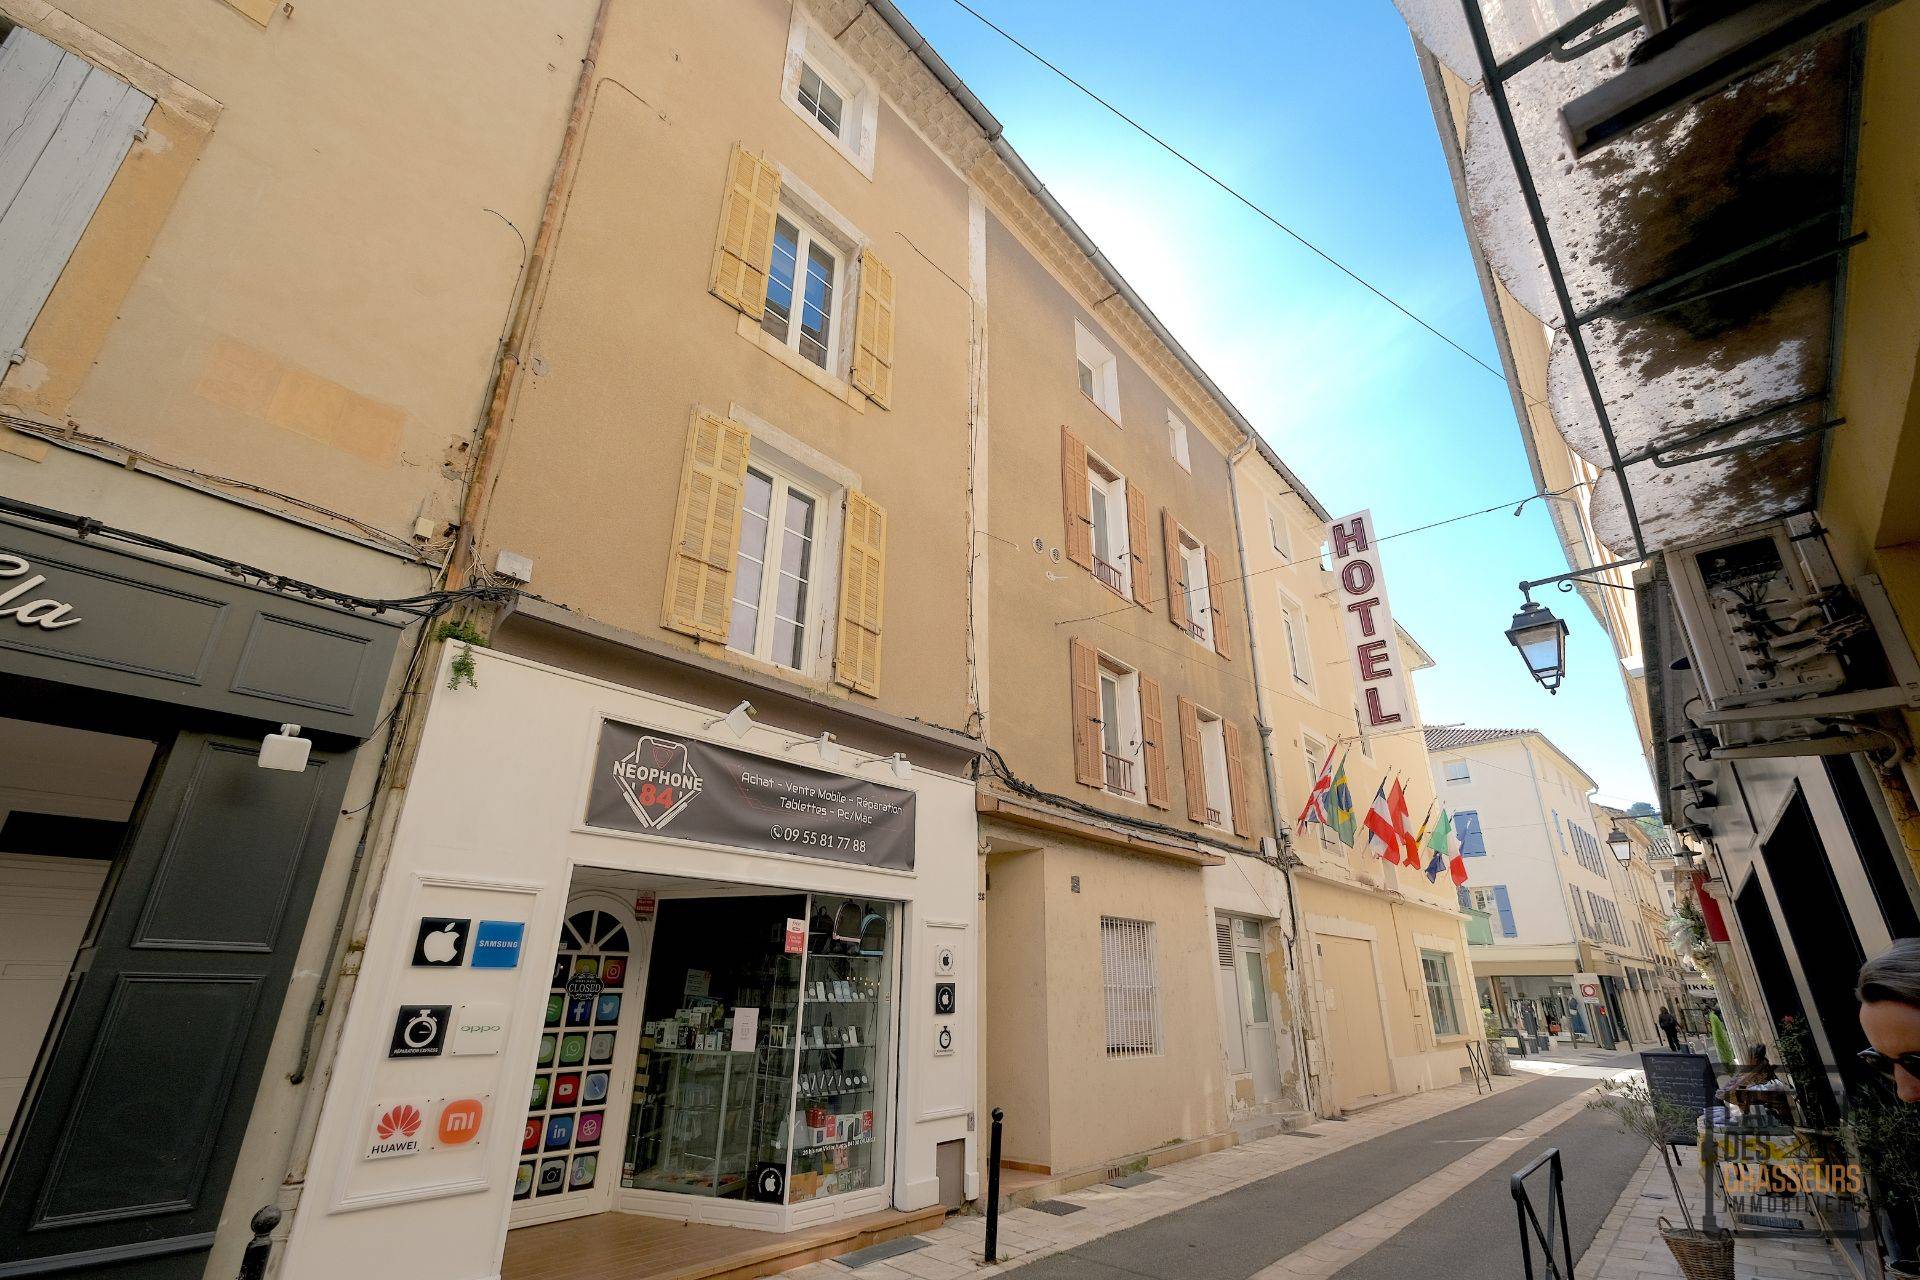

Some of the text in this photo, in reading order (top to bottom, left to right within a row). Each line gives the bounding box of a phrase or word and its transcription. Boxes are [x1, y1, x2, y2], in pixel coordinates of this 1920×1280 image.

[1332, 517, 1401, 726] HOTEL
[613, 761, 704, 792] NEOPHONE
[639, 783, 674, 809] 84
[741, 772, 775, 788] Achat
[785, 781, 816, 797] Vente
[817, 788, 847, 805] Mobile
[856, 797, 904, 816] Réparation
[780, 796, 827, 815] Tablettes
[837, 808, 873, 824] Pc/Mac
[784, 827, 866, 852] 09 55 81 77 88
[479, 940, 518, 948] SAMSUNG
[569, 983, 601, 993] CLOSED
[371, 1141, 418, 1154] HUAWEI
